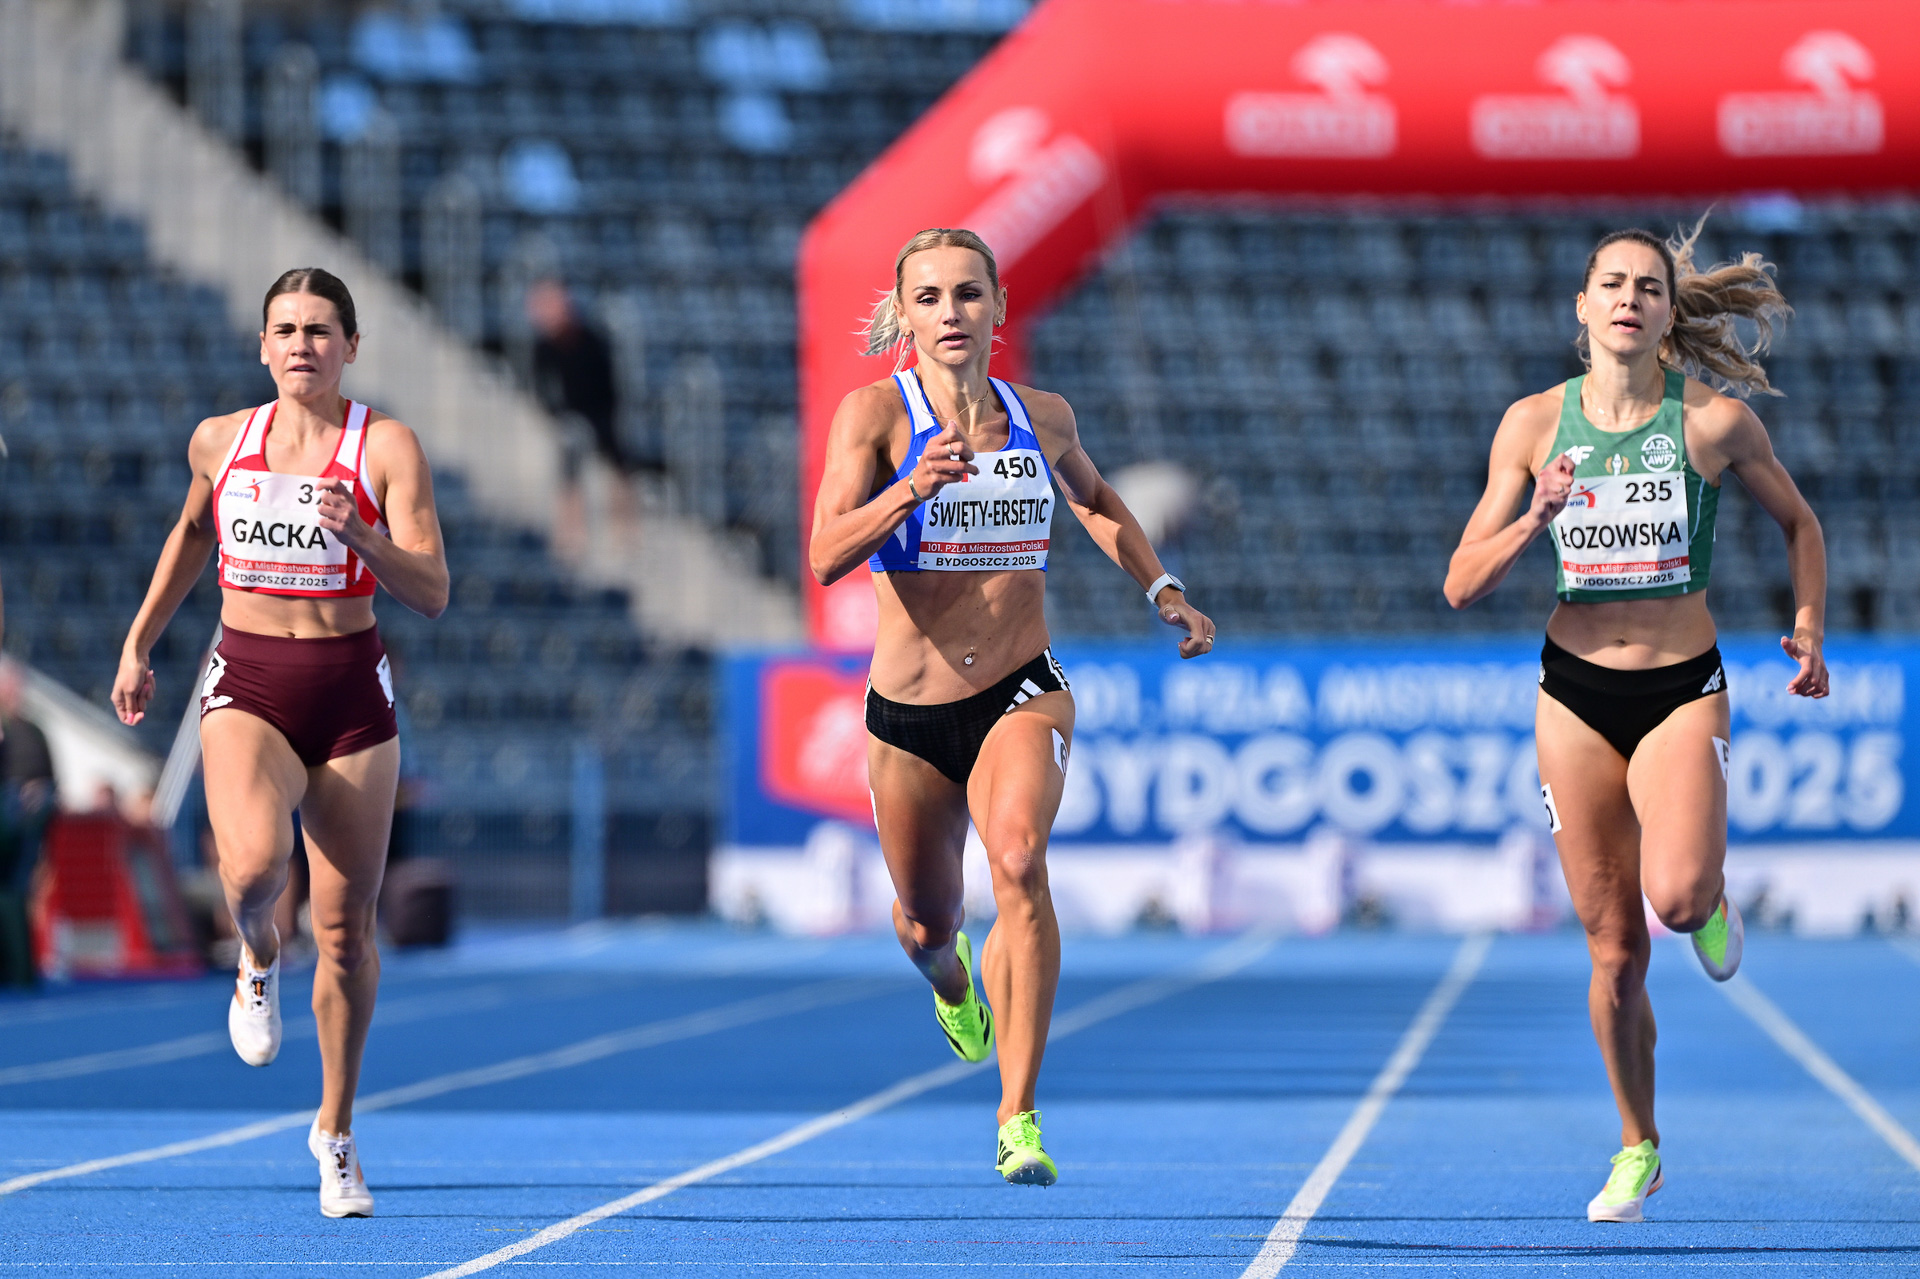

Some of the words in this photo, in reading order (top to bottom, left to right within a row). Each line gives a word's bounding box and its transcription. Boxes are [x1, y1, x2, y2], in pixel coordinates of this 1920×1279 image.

[1648, 440, 1669, 450] AZS
[1647, 454, 1673, 465] AWF
[993, 456, 1037, 479] 450
[1624, 480, 1673, 503] 235
[928, 496, 1050, 533] ŚWIĘTY-ERSETIC
[232, 518, 328, 550] GACKA
[1560, 521, 1682, 549] ŁOZOWSKA
[927, 543, 943, 553] 101.
[945, 544, 967, 553] PZLA
[969, 543, 1020, 553] Mistrzostwa
[1021, 541, 1044, 551] Polski
[255, 561, 310, 573] Mistrzostwa
[311, 565, 339, 574] Polski
[936, 557, 1010, 567] BYDGOSZCZ
[1012, 556, 1037, 566] 2025
[1601, 562, 1656, 573] Mistrzostwa
[1657, 560, 1682, 570] Polski
[231, 572, 297, 585] BYDGOSZCZ
[299, 577, 329, 587] 2025
[1575, 575, 1644, 587] BYDGOSZCZ
[1646, 572, 1674, 584] 2025
